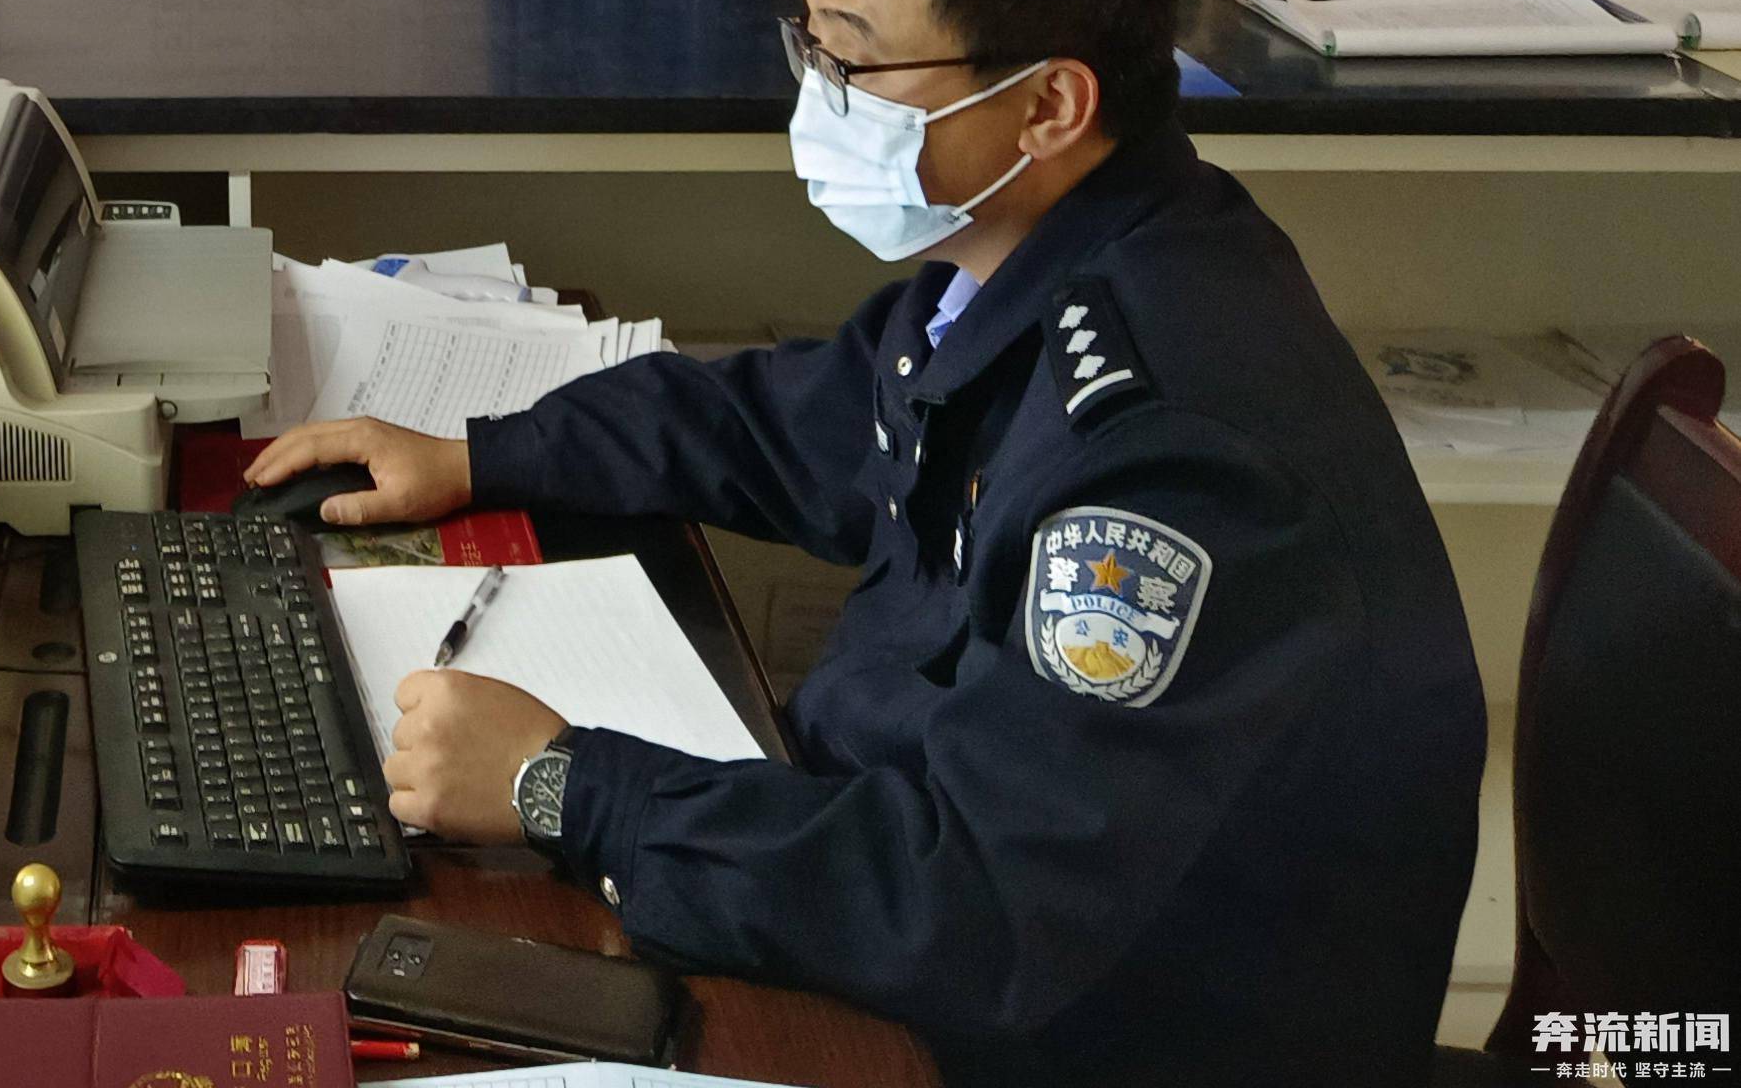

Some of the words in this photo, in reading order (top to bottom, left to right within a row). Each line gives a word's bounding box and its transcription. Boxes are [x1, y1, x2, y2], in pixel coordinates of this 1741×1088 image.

[1046, 519, 1197, 585] 中华人民共和国
[1047, 556, 1081, 593] 警
[1137, 574, 1179, 614] 察
[1071, 594, 1139, 621] POLICE
